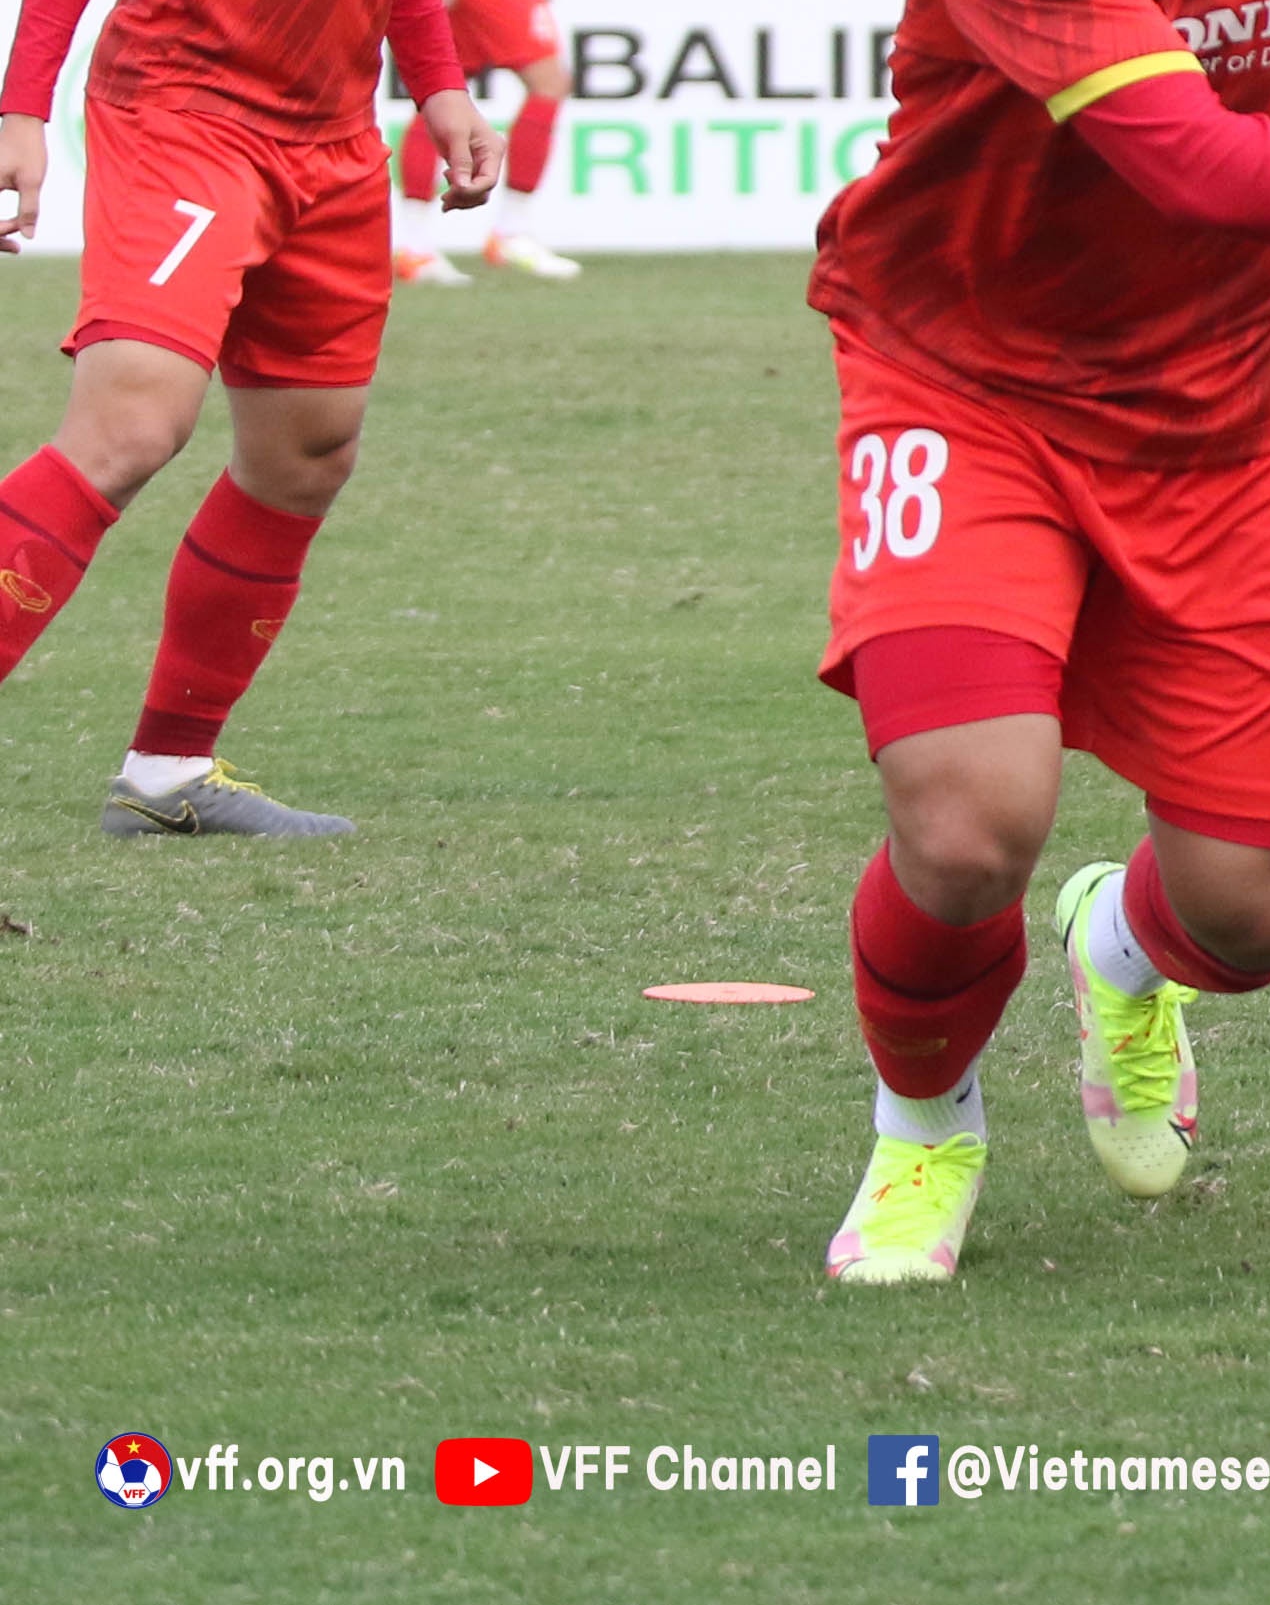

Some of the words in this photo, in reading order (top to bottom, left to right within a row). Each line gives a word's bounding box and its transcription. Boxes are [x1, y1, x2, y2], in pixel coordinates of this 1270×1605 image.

[1227, 50, 1256, 73] of
[148, 198, 217, 287] 7
[852, 428, 949, 572] 38
